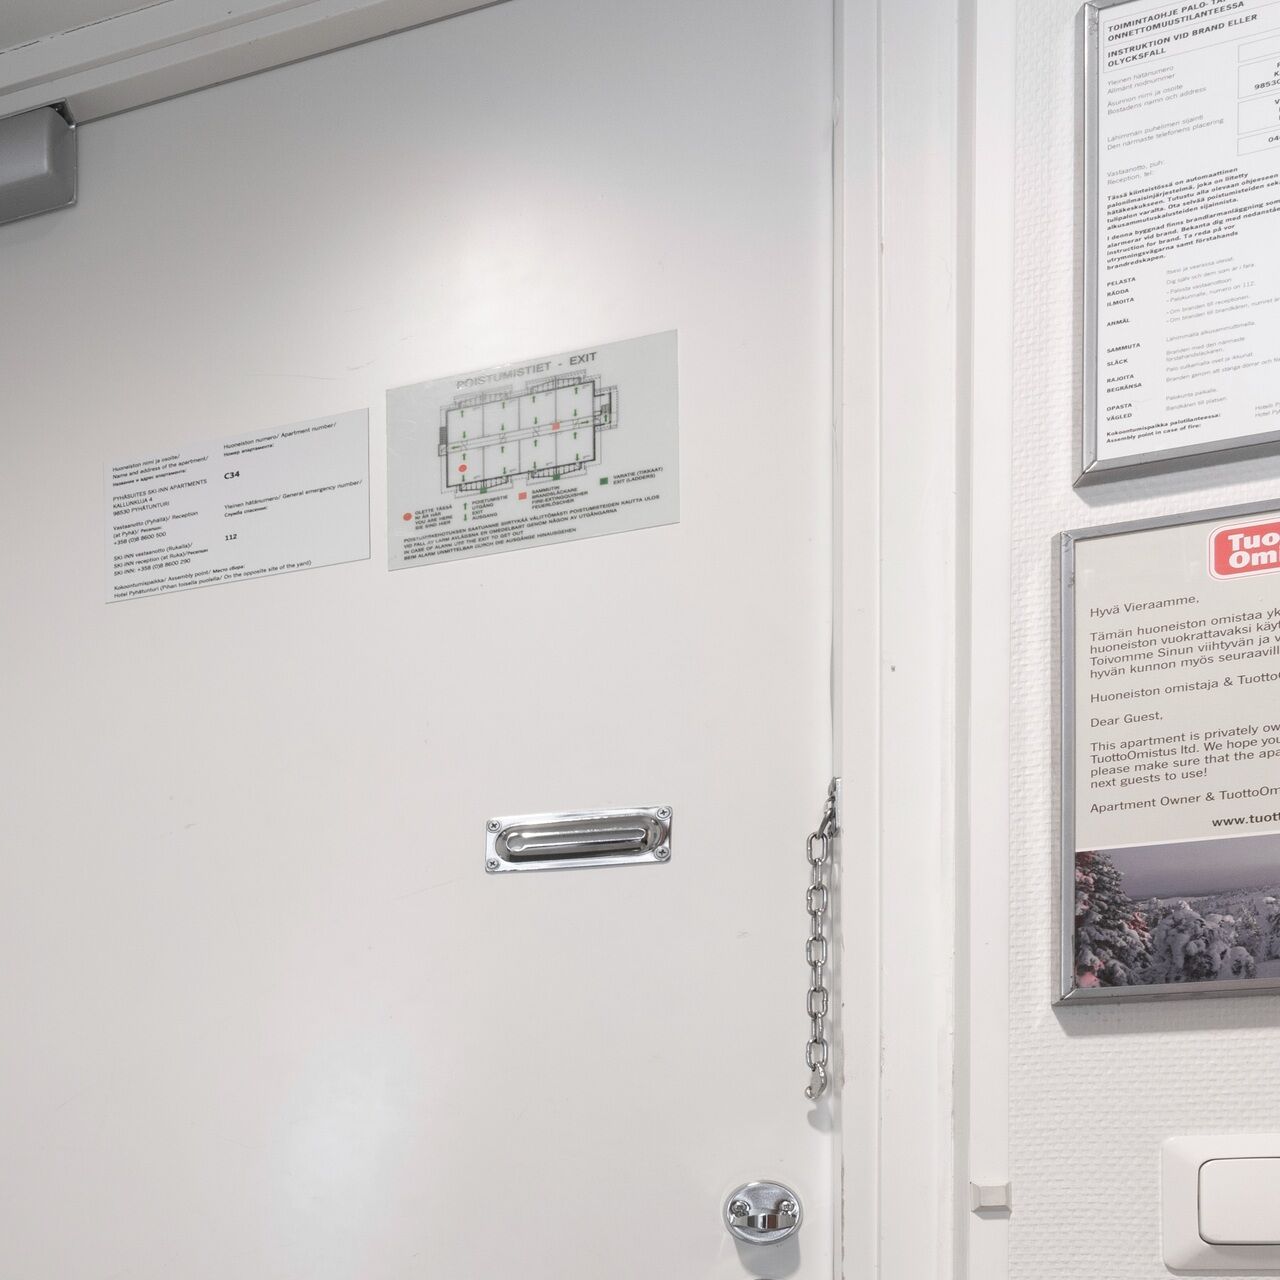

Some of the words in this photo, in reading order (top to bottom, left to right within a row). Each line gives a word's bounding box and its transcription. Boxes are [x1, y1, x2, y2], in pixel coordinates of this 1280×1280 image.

[1107, 8, 1178, 32] TOIMINTAOHJE
[1180, 1, 1207, 13] PALO-
[1107, 0, 1244, 42] ONNETTOMUUSTILANTEESSA
[1107, 36, 1171, 58] INSTRUKTION
[1172, 31, 1189, 41] VID
[1191, 22, 1225, 36] BRAND
[1227, 13, 1258, 27] ELLER
[1107, 47, 1165, 67] OLYCKSFALL
[568, 351, 597, 366] EXIT
[223, 470, 240, 480] C34
[1228, 545, 1280, 569] Om
[1089, 604, 1120, 618] Hyvä
[1123, 595, 1199, 613] Vieraamme,
[1089, 628, 1133, 642] Tämän
[1136, 619, 1206, 636] huoneiston
[1210, 611, 1262, 626] omistaa
[1089, 638, 1157, 654] huoneiston
[1160, 623, 1252, 645] vuokrattavaksi
[1089, 651, 1154, 666] Toivomme
[1157, 645, 1193, 658] Sinun
[1197, 636, 1254, 652] viihtyvän
[1257, 634, 1270, 647] ja
[1089, 666, 1126, 680] hyvän
[1129, 660, 1176, 674] kunnon
[1180, 654, 1214, 668] myös
[1090, 687, 1160, 703] Huoneiston
[1164, 679, 1219, 694] omistaja
[1223, 676, 1233, 687] &
[1090, 717, 1120, 728] Dear
[1123, 711, 1163, 724] Guest,
[1089, 741, 1116, 752] This
[1119, 732, 1186, 750] apartment
[1189, 731, 1200, 741] is
[1204, 724, 1259, 741] privately
[1089, 747, 1177, 764] TuottoOmistus
[1180, 743, 1200, 754] ltd.
[1202, 741, 1223, 752] We
[1226, 738, 1258, 750] hope
[1090, 765, 1130, 778] please
[1134, 759, 1169, 772] make
[1172, 757, 1200, 768] sure
[1203, 752, 1230, 764] that
[1233, 750, 1254, 761] the
[1090, 777, 1116, 789] next
[1119, 773, 1161, 788] guests
[1164, 771, 1177, 781] to
[1180, 766, 1207, 779] use!
[1089, 797, 1156, 814] Apartment
[1159, 794, 1201, 806] Owner
[1204, 791, 1215, 802] &
